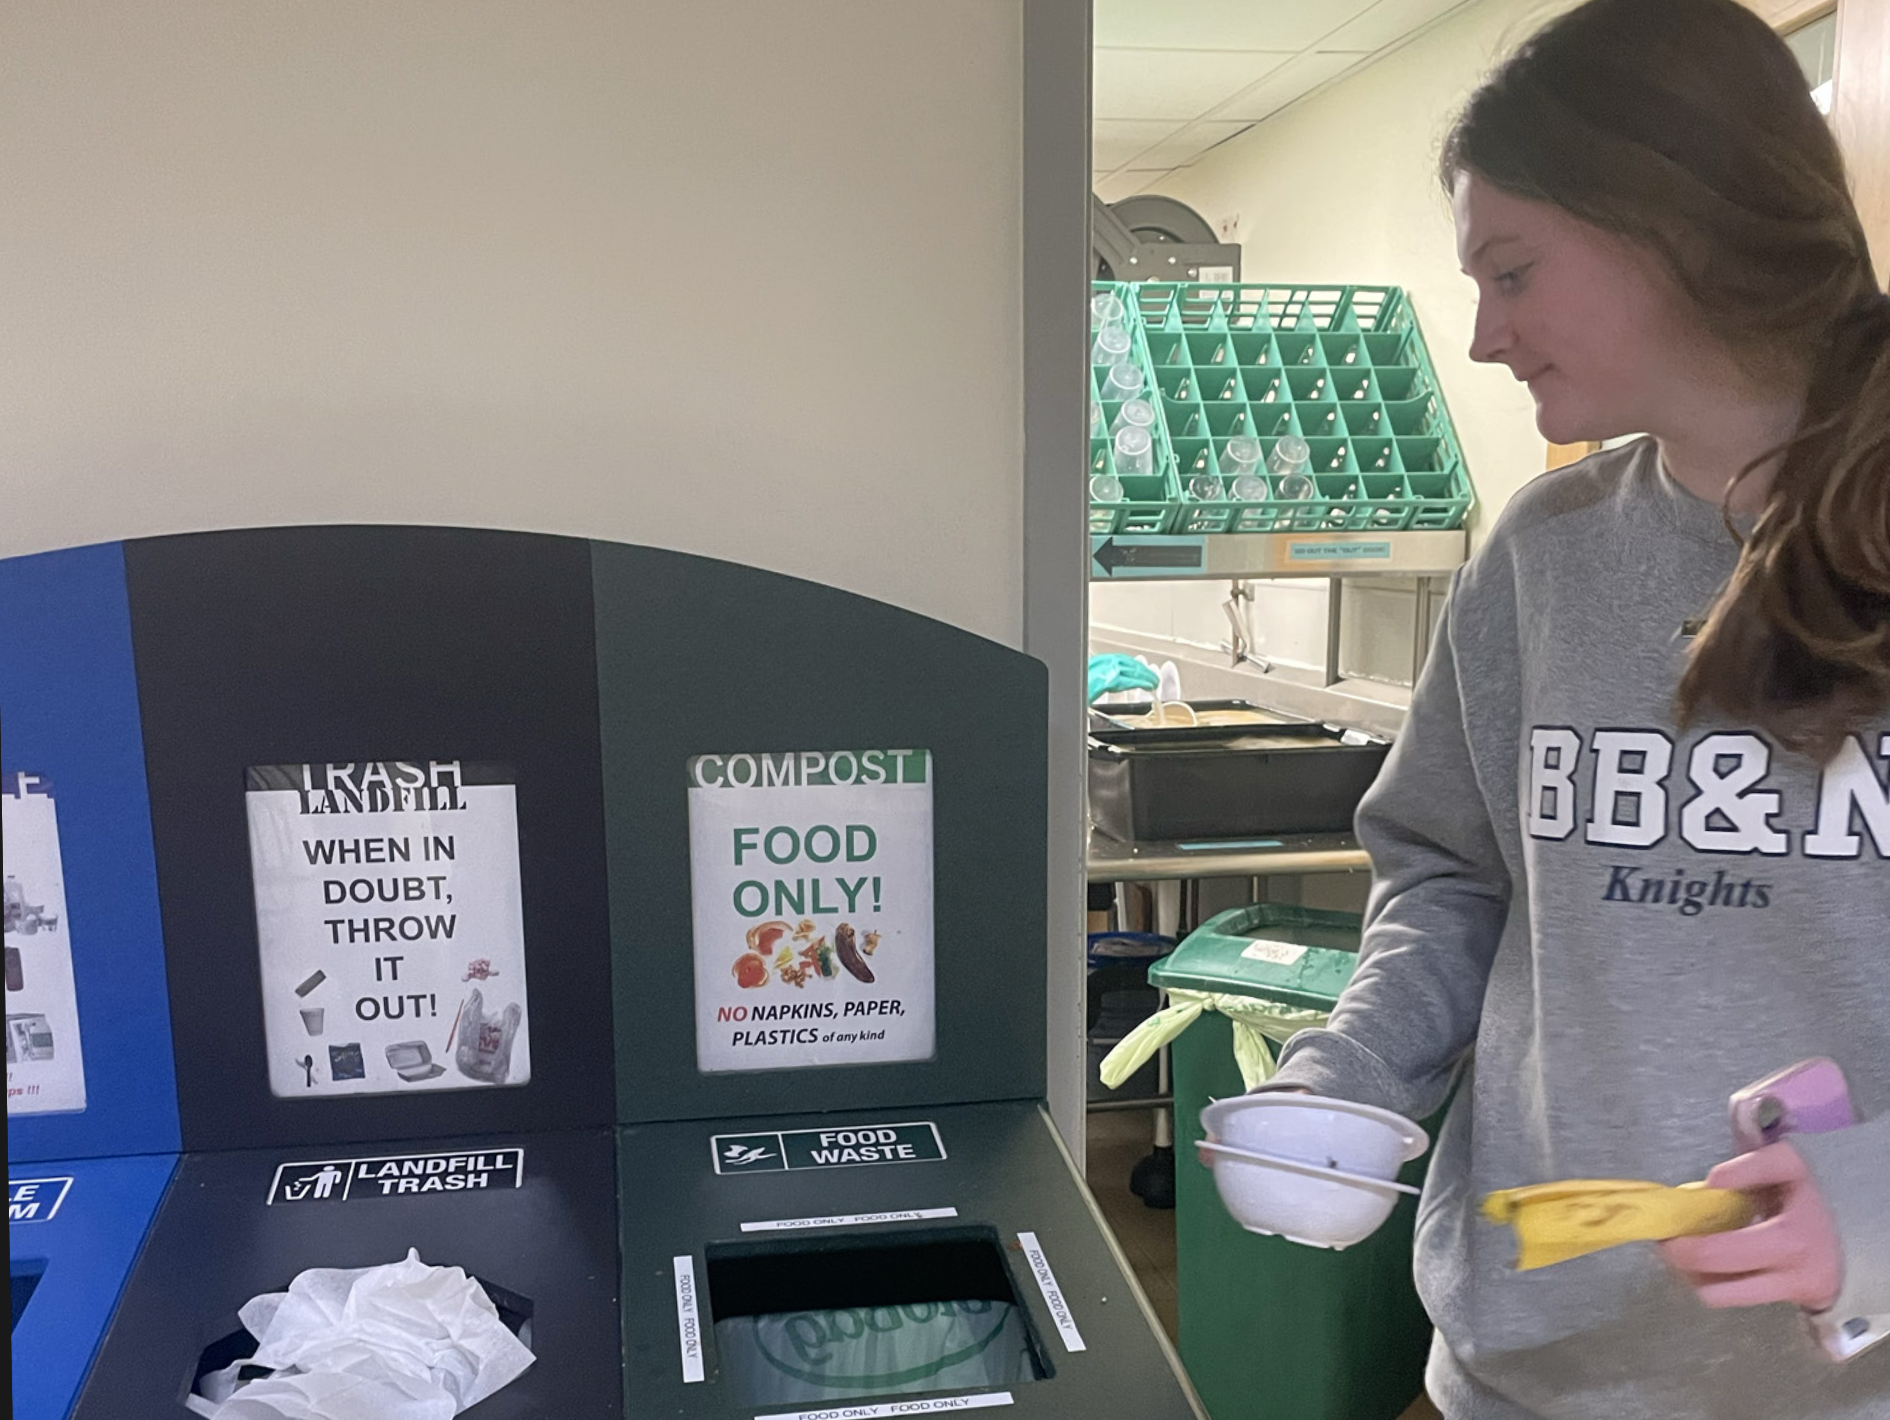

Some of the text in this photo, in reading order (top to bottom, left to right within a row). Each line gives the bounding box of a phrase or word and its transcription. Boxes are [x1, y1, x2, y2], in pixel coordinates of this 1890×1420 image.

[695, 749, 913, 788] COMPOST
[300, 786, 467, 815] LANDFILL
[302, 835, 455, 865] WHEN IN
[733, 824, 877, 866] FOOD
[323, 876, 452, 904] DOUBT,
[733, 877, 881, 917] ONLY!
[1602, 865, 1772, 916] Knights
[324, 914, 456, 944] THROW
[375, 956, 404, 981] IT
[355, 994, 437, 1021] OUT!
[717, 1000, 906, 1022] NO NAPKINS, PAPER,
[732, 1028, 885, 1046] PLASTICS of any kind
[819, 1129, 897, 1147] FOOD
[358, 1154, 513, 1178] LANDFILL
[810, 1144, 917, 1164] WASTE
[378, 1173, 489, 1194] TRASH
[776, 1212, 923, 1227] FOOD ONLY FOOD ONLY
[1029, 1249, 1073, 1330] FOOD ONLY FOOD ONLY
[680, 1274, 698, 1358] FOOD ONLY FOOD ONLY
[843, 1407, 879, 1418] ONLY
[891, 1402, 930, 1413] FOOD
[933, 1398, 970, 1409] ONLY
